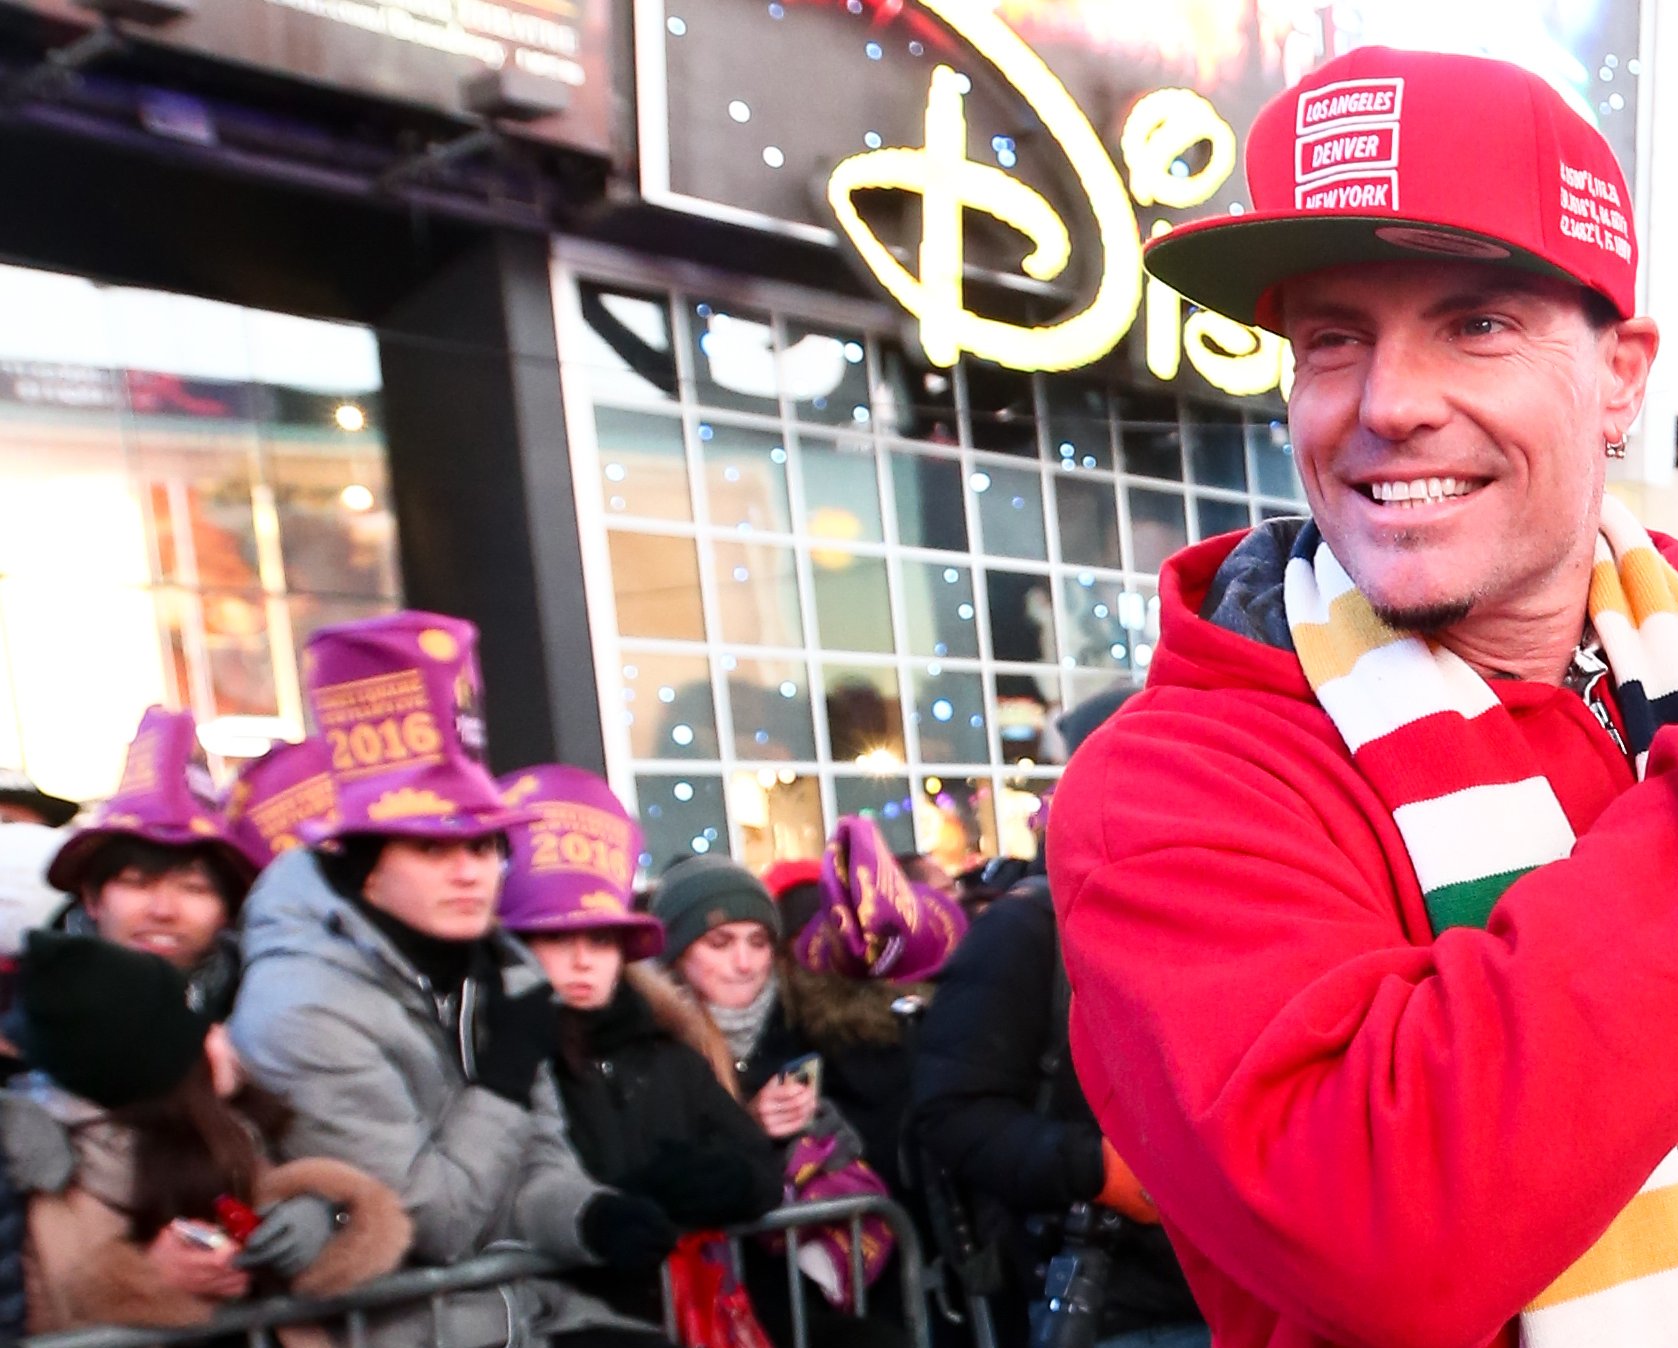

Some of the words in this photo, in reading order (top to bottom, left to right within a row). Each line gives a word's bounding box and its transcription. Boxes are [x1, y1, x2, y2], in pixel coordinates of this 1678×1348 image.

[1312, 134, 1380, 168] DENVER
[827, 0, 1293, 396] Dis
[326, 711, 442, 769] 2016
